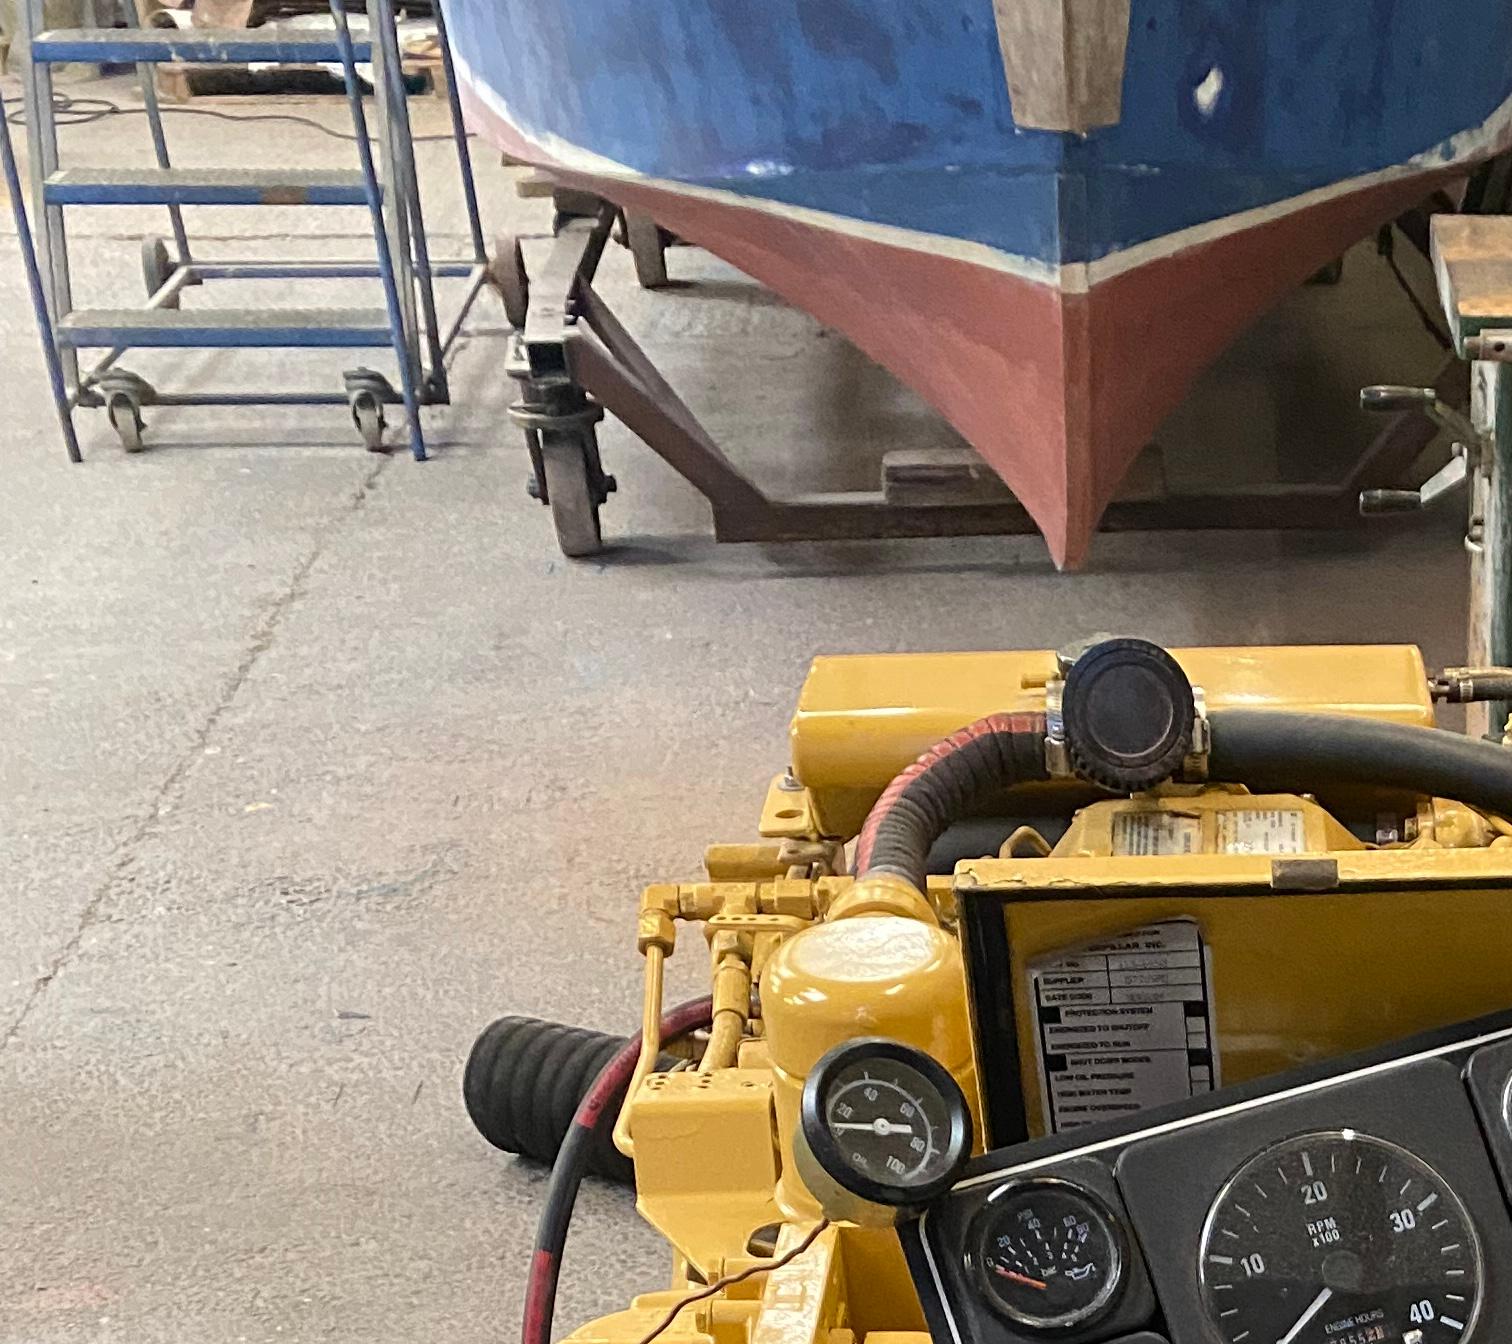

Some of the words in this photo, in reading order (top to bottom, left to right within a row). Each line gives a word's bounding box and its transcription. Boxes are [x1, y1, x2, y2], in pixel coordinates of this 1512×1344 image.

[836, 1102, 854, 1119] 20
[886, 1155, 906, 1175] 100
[1301, 1181, 1328, 1205] 20
[1307, 1217, 1337, 1237] RPM
[1389, 1208, 1416, 1232] 30
[997, 1235, 1011, 1248] 20
[1312, 1230, 1340, 1248] x100
[1240, 1253, 1265, 1277] 10
[1324, 1316, 1354, 1335] ENGINE
[1355, 1308, 1385, 1324] HOURS
[1409, 1300, 1435, 1323] 40
